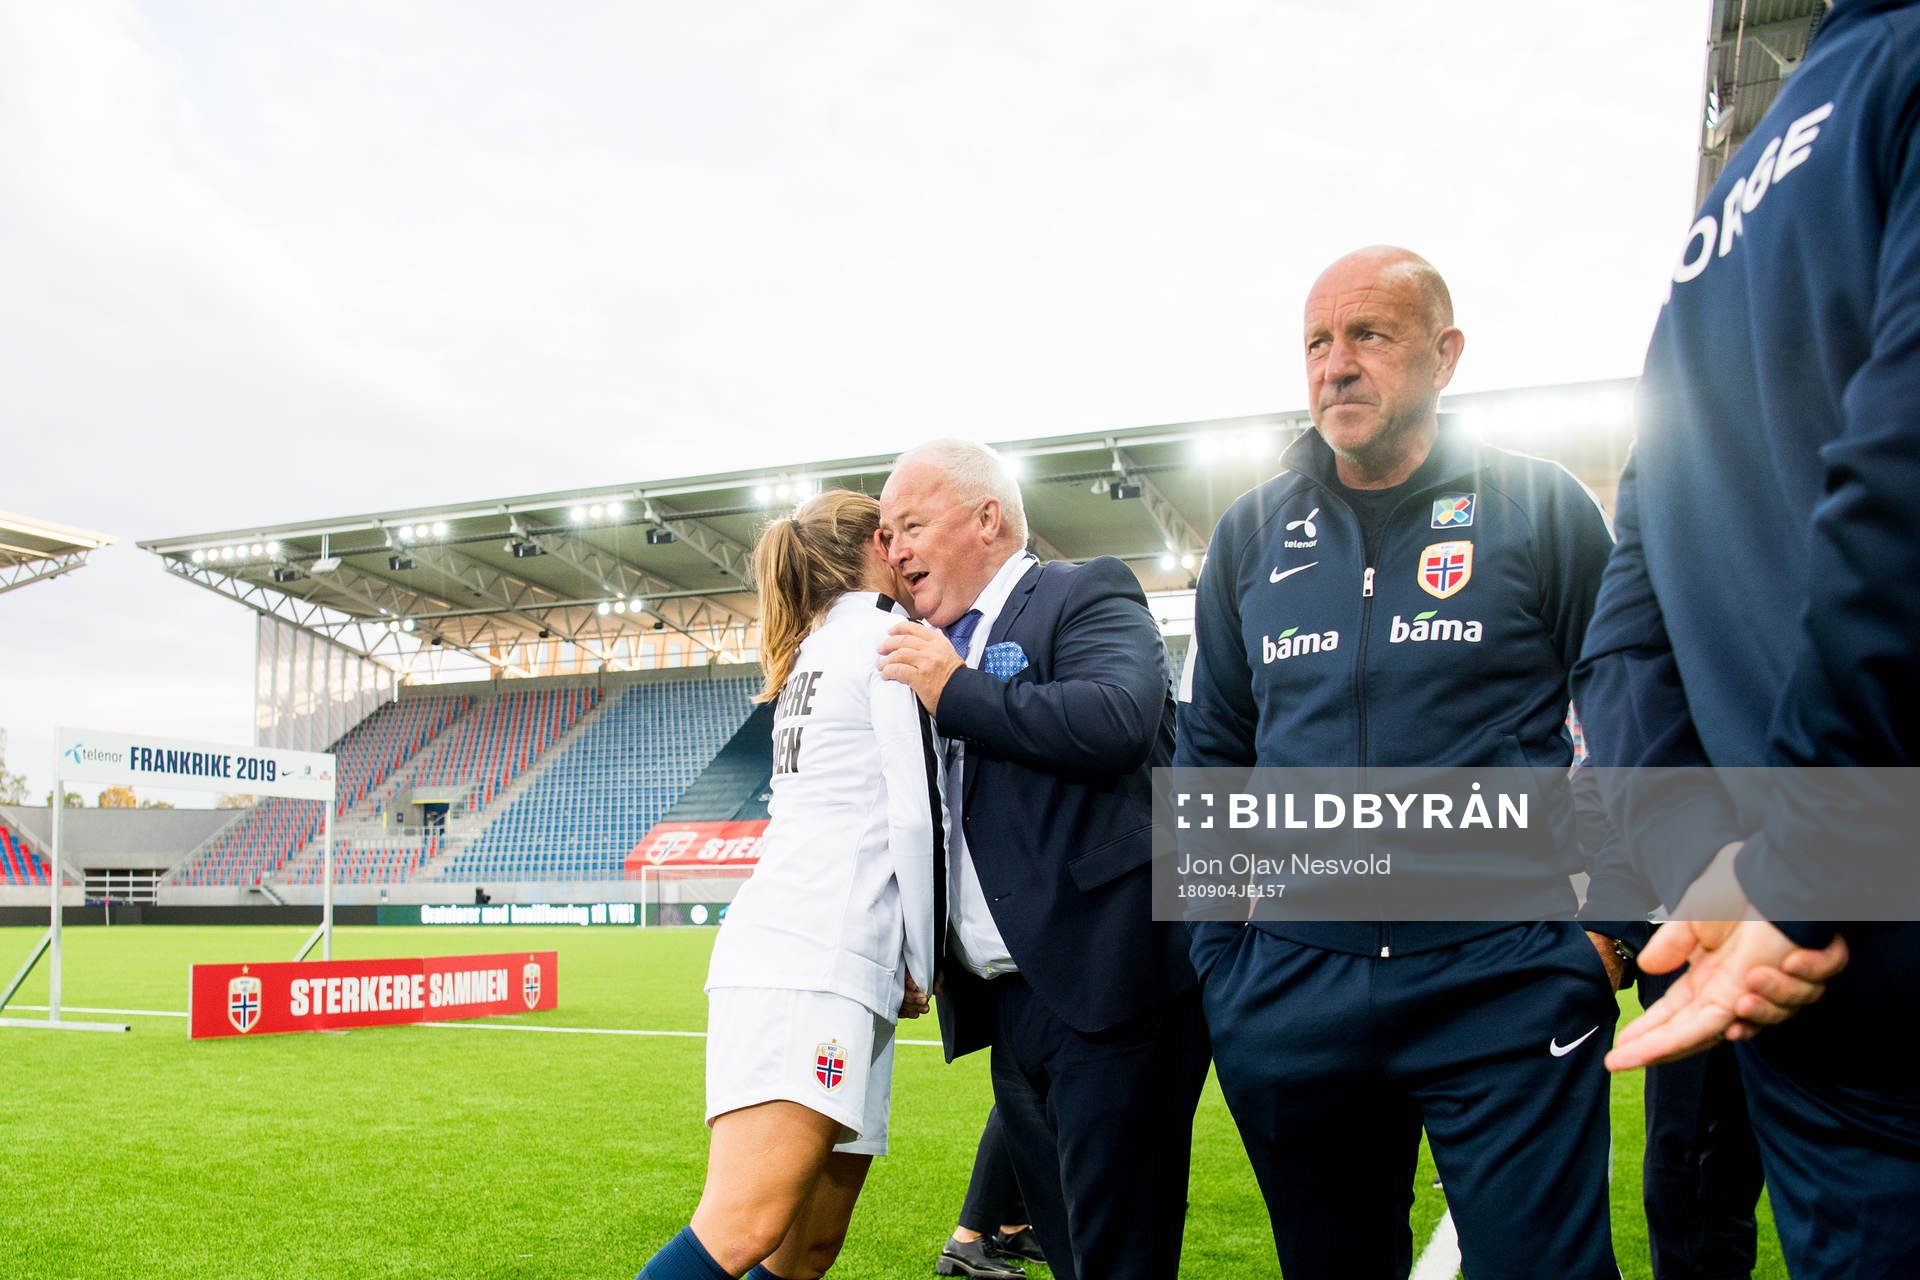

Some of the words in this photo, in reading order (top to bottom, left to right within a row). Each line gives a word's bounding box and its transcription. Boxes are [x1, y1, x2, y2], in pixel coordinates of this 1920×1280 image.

[1664, 101, 1834, 304] ORGE
[1284, 539, 1318, 549] telenor
[778, 671, 824, 718] ERE
[82, 747, 123, 763] telenor
[130, 746, 231, 778] FRANKRIKE
[236, 757, 276, 782] 2019
[774, 727, 804, 774] EN
[290, 974, 426, 1016] STERKERE
[429, 968, 508, 1008] SAMMEN
